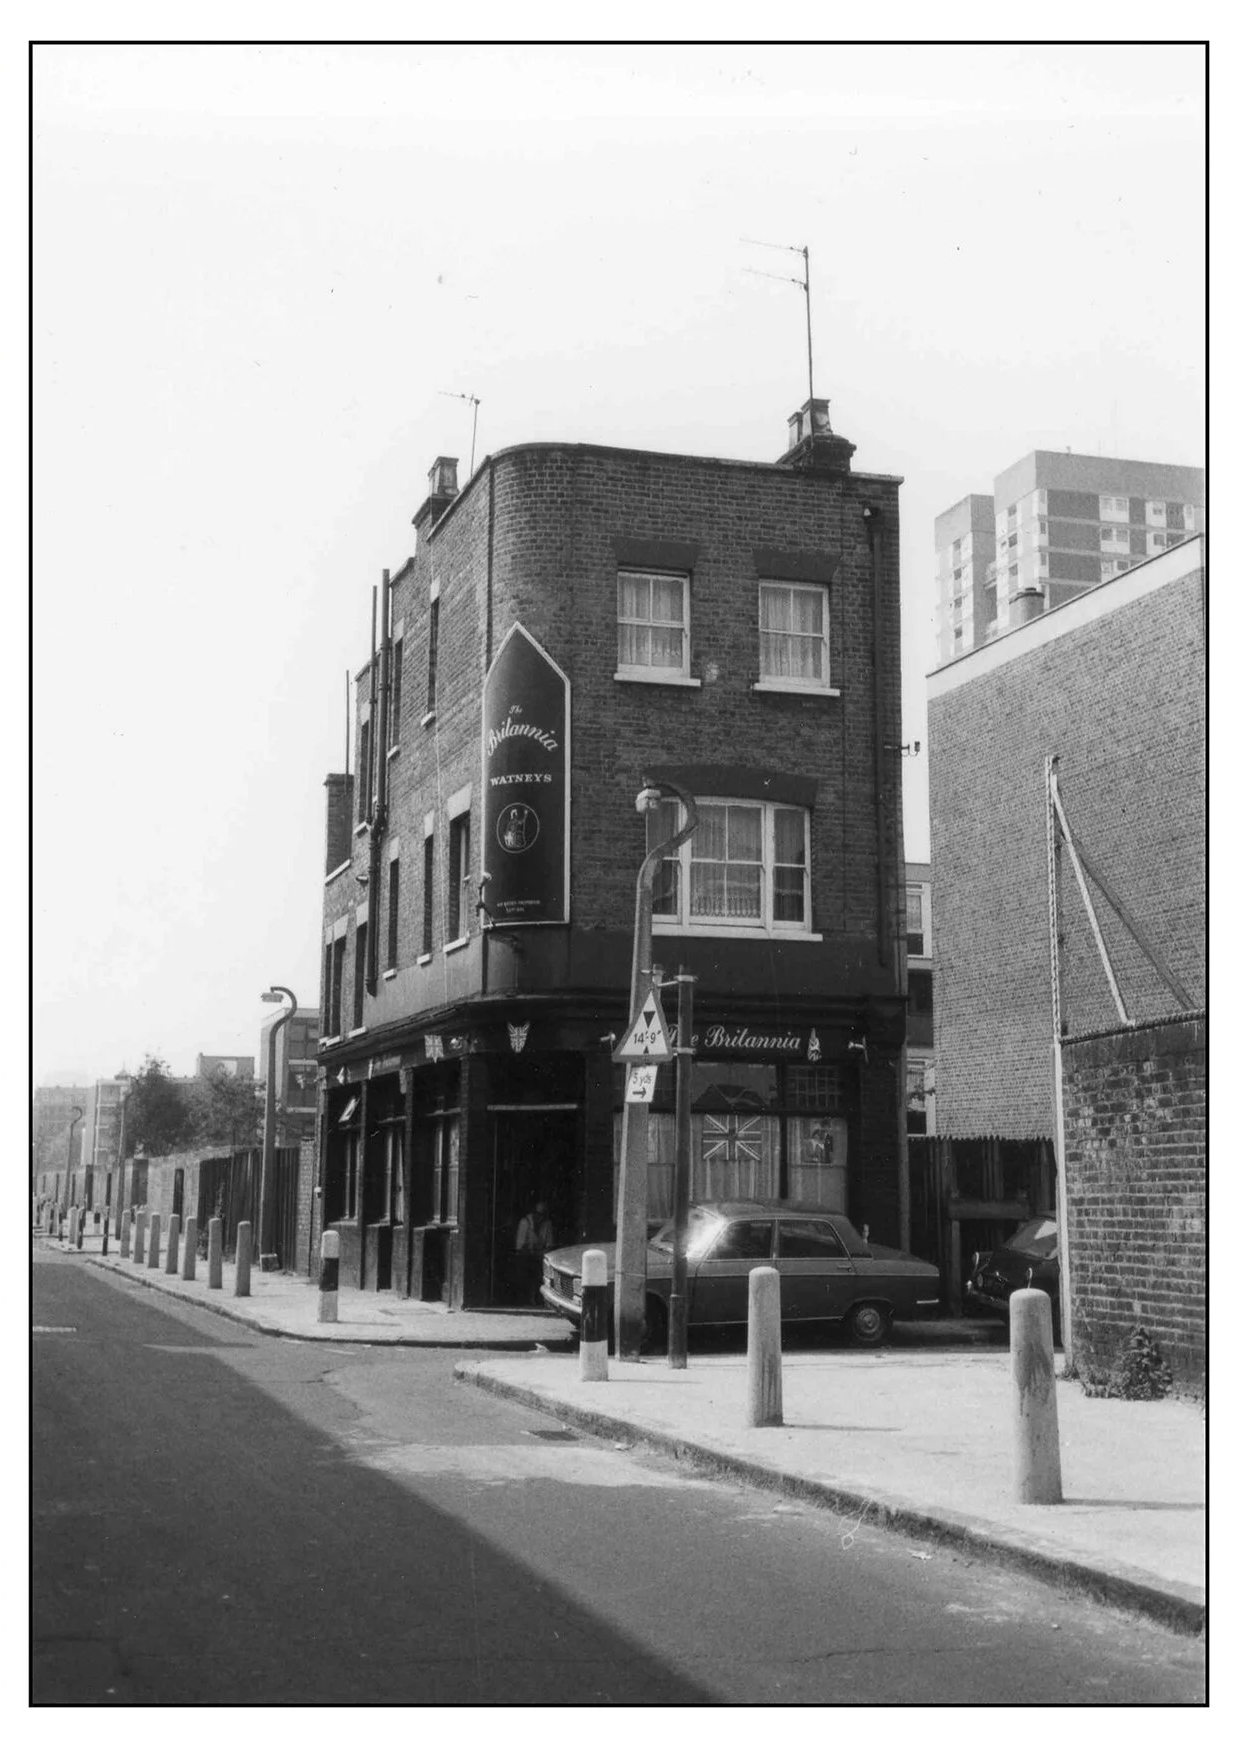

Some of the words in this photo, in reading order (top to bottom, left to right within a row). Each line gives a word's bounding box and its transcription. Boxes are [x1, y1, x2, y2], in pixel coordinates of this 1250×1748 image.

[488, 717, 559, 756] Britannia
[490, 773, 552, 787] WATNEYS
[669, 1023, 699, 1047] Te
[704, 1025, 801, 1050] Britannia
